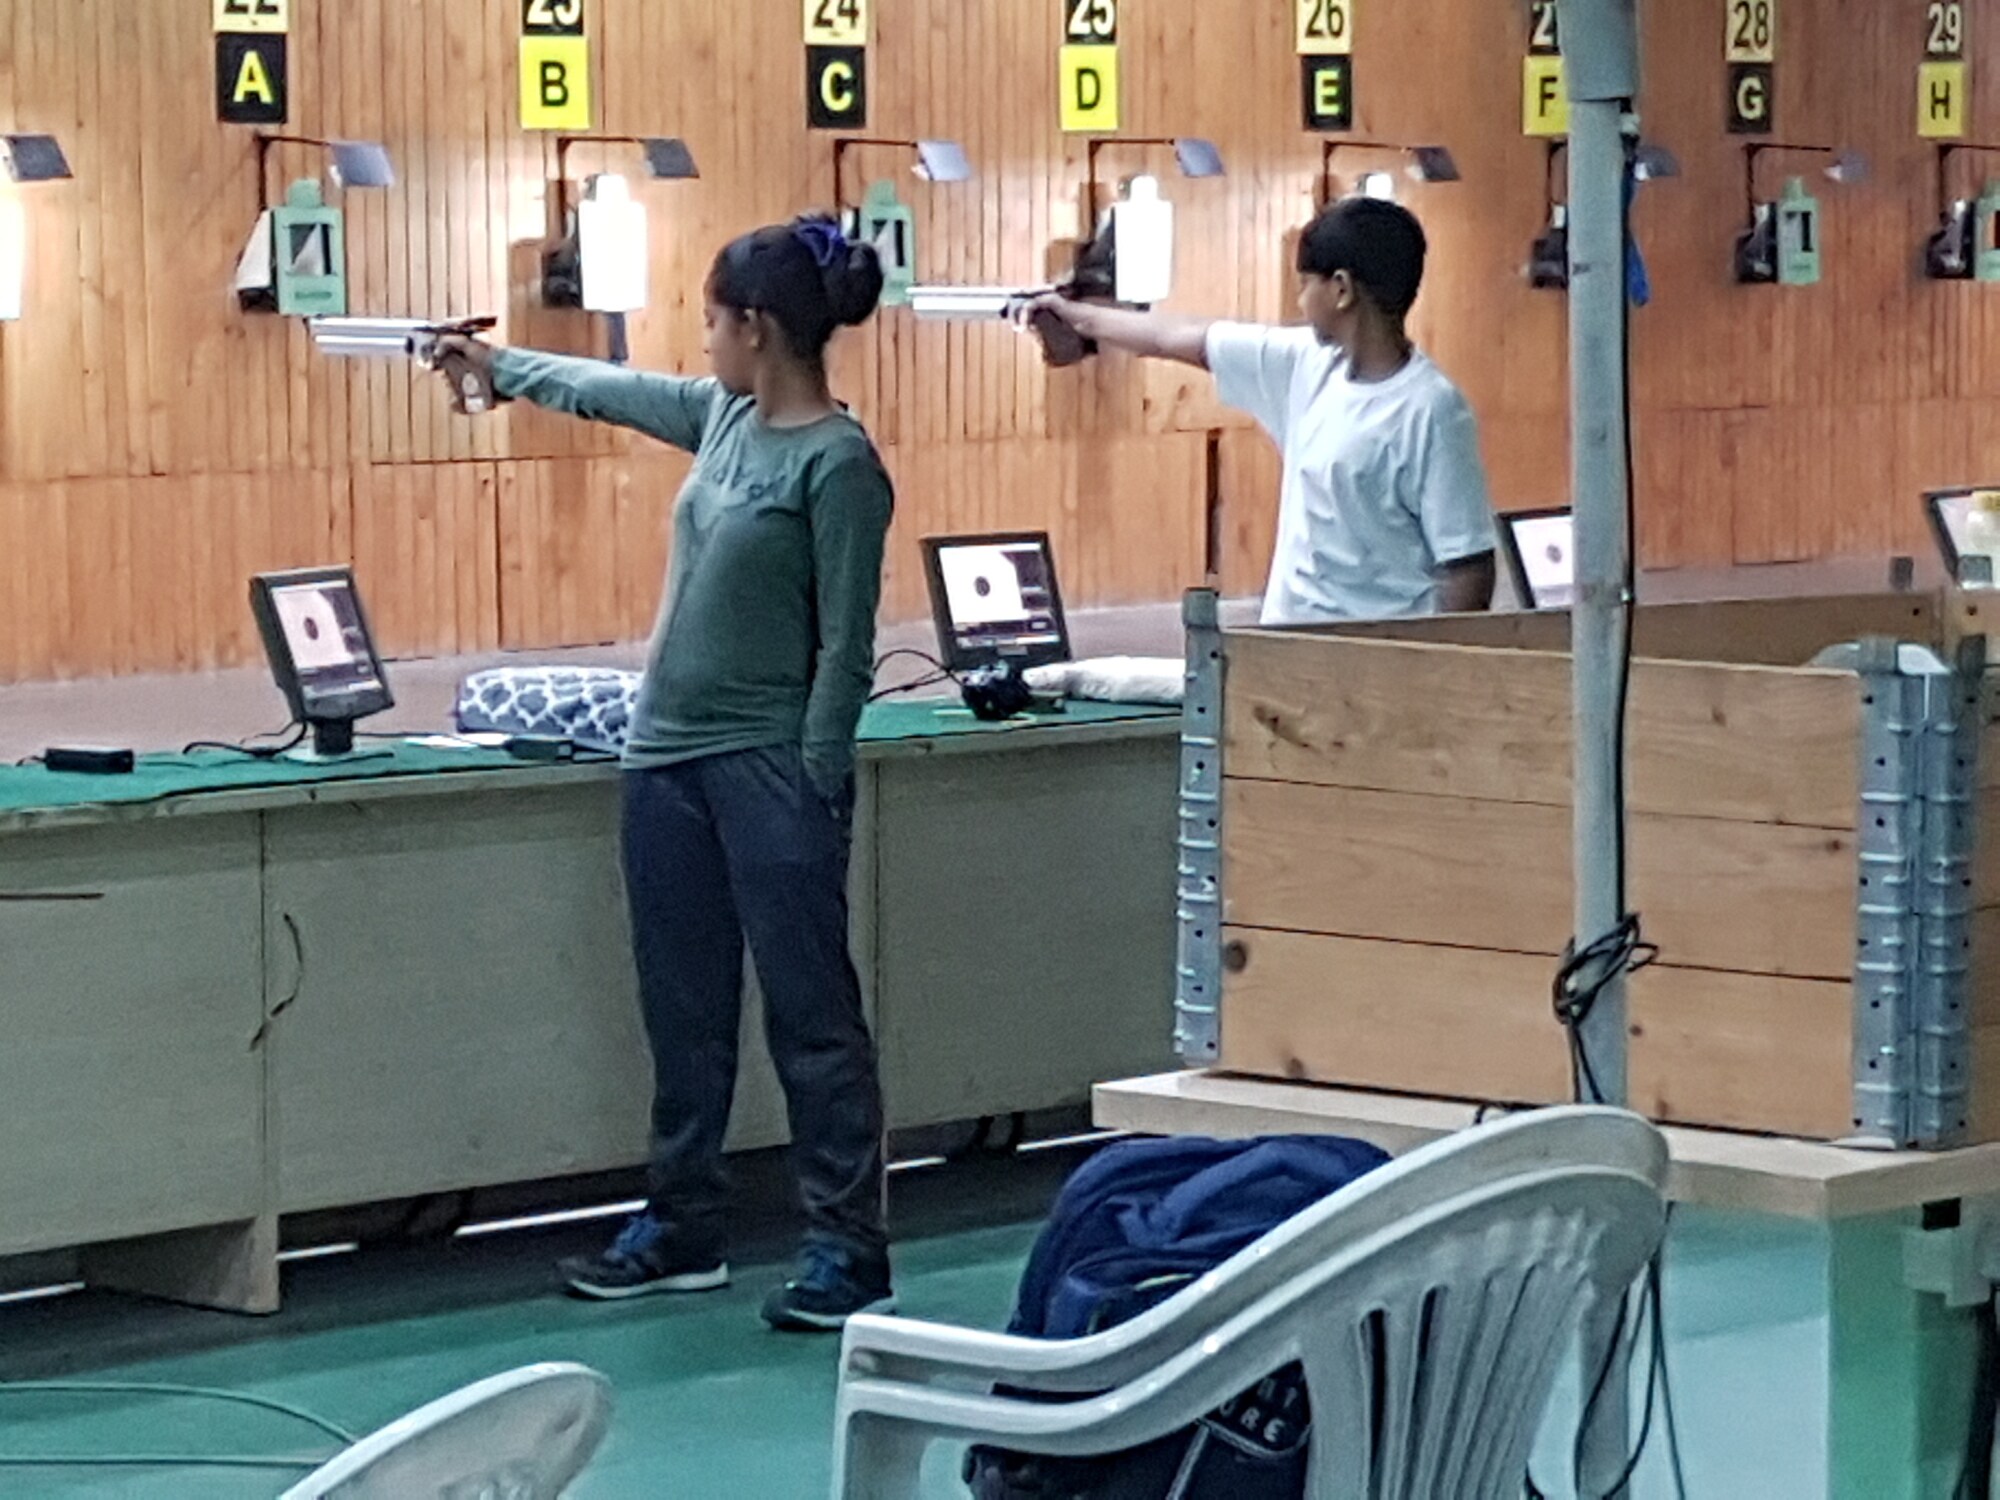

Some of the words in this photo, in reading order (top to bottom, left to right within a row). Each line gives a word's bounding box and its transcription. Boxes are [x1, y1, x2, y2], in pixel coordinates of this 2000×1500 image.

[1068, 0, 1115, 35] 25
[1305, 0, 1344, 38] 26
[1531, 2, 1553, 45] 2
[1734, 1, 1768, 48] 28
[1928, 2, 1961, 52] 29
[233, 50, 273, 104] A
[540, 60, 569, 107] B
[821, 61, 854, 111] C
[1076, 67, 1101, 110] D
[1315, 69, 1341, 115] E
[1539, 76, 1558, 117] F
[1737, 76, 1763, 119] G
[1930, 81, 1950, 120] H
